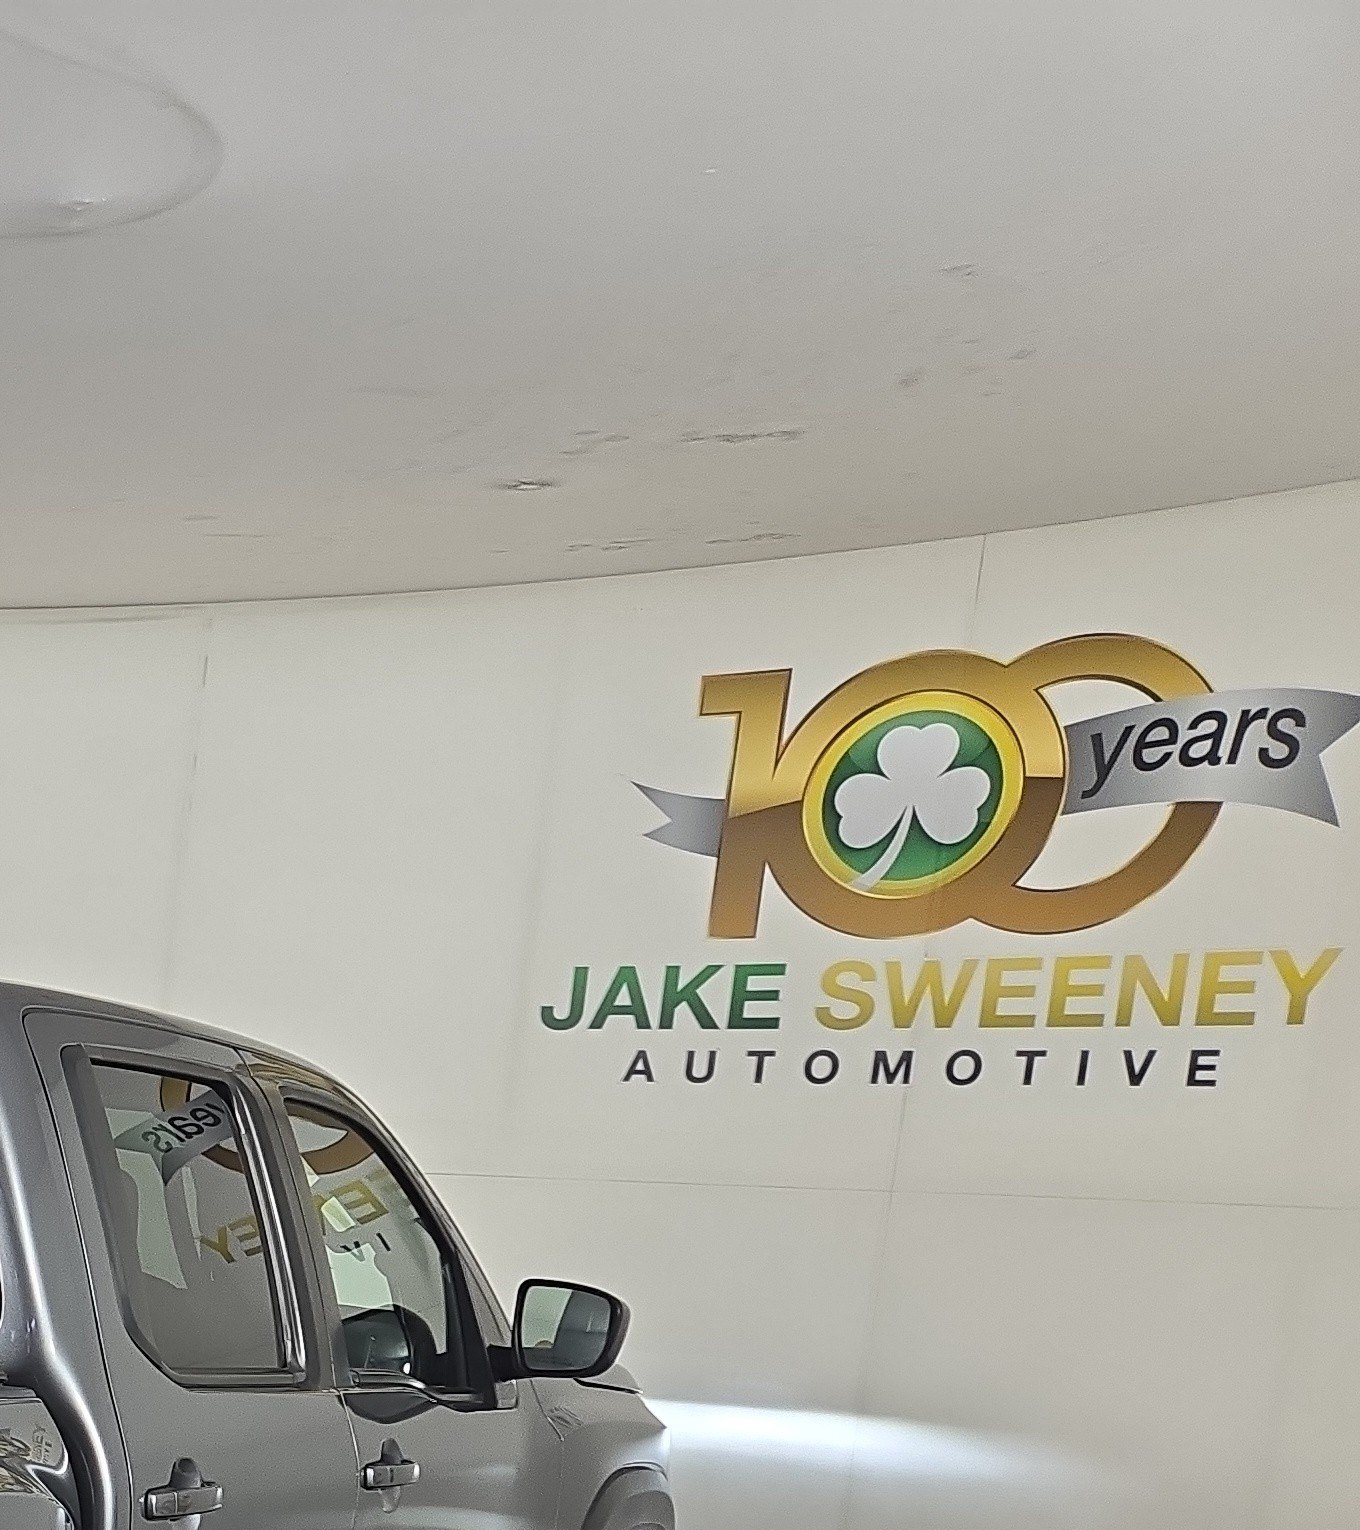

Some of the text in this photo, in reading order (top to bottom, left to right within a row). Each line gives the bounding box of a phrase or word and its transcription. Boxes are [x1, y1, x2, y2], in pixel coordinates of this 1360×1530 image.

[700, 632, 1224, 939] 100
[1080, 706, 1306, 798] years
[540, 947, 1344, 1031] JAKE SWEENEY
[623, 1049, 1223, 1088] AUTOMOTIVE
